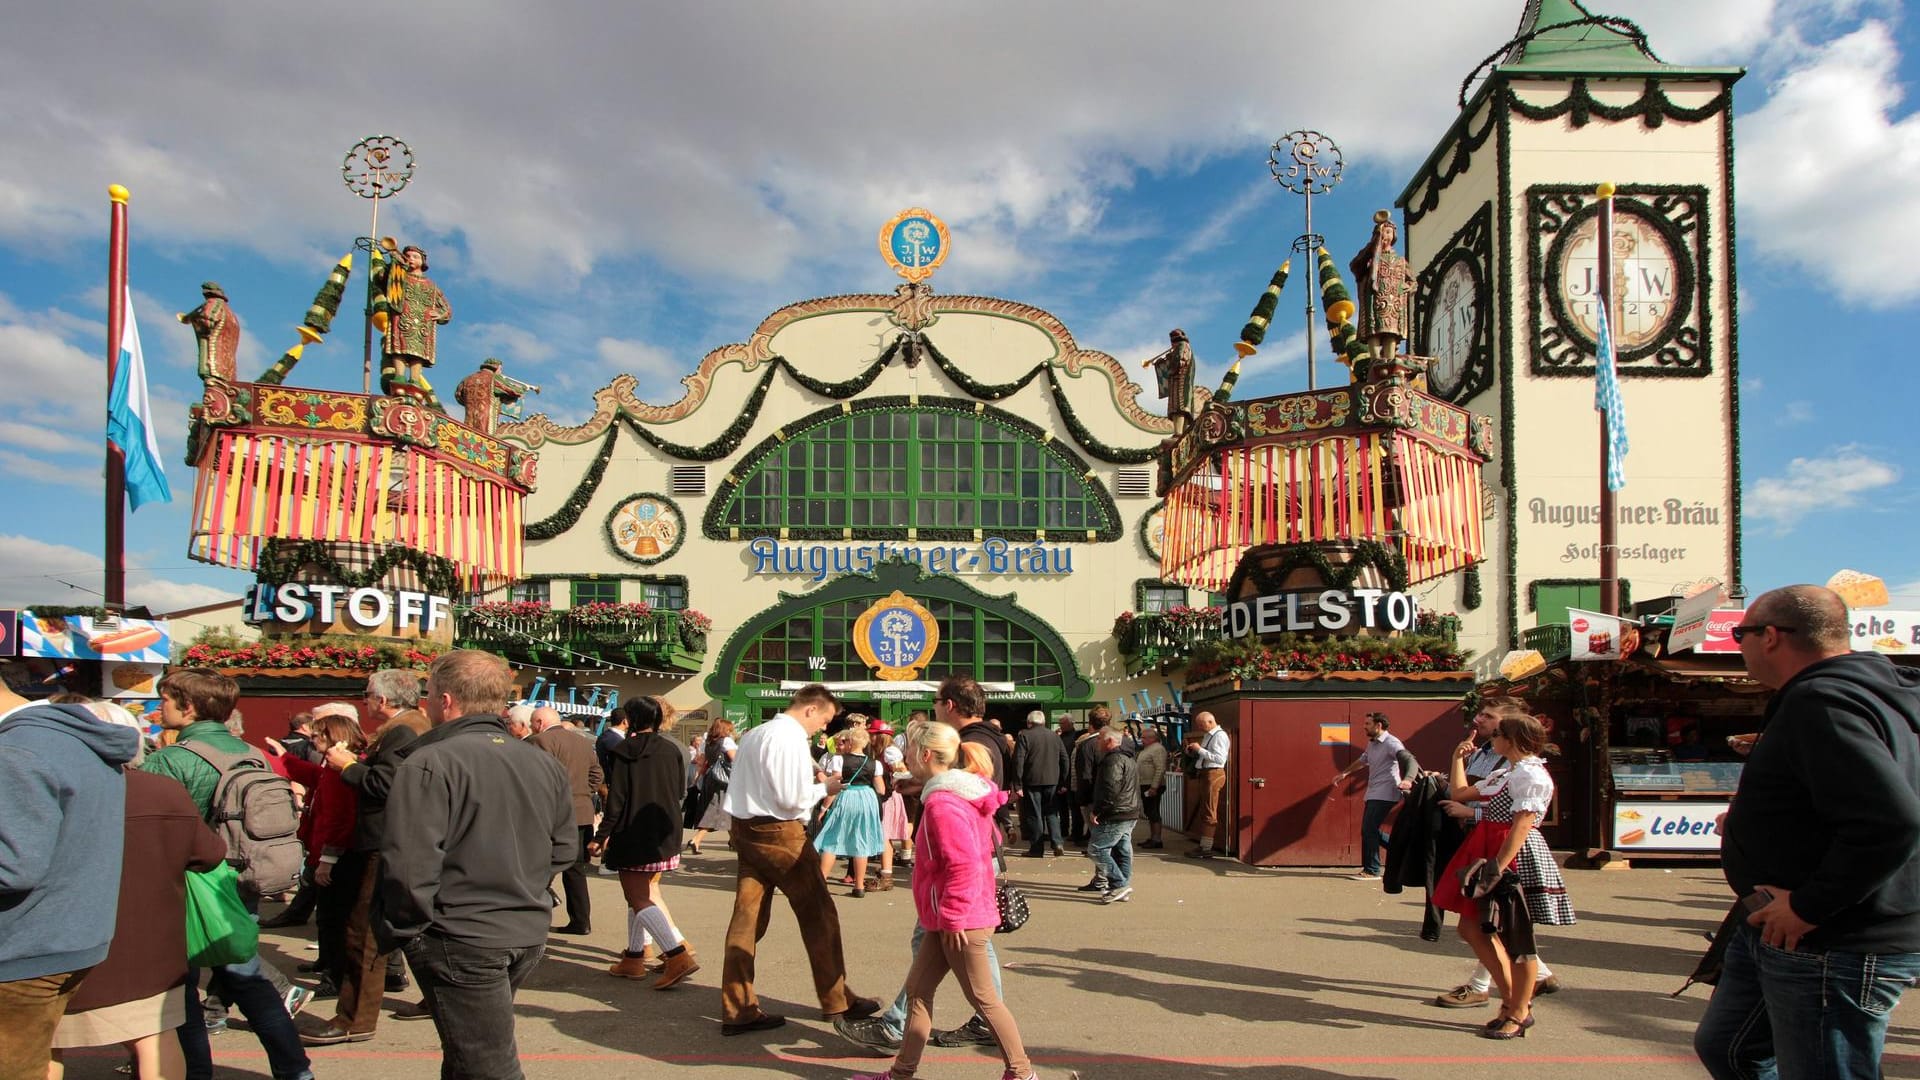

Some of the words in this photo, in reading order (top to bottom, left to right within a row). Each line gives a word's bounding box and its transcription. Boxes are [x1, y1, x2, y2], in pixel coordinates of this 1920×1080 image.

[1528, 497, 1719, 527] Augusner-Bräu
[1560, 543, 1687, 563] Holsslager
[809, 657, 826, 670] W2
[880, 654, 891, 662] 13
[902, 654, 914, 662] 28
[1651, 816, 1719, 836] Leber
